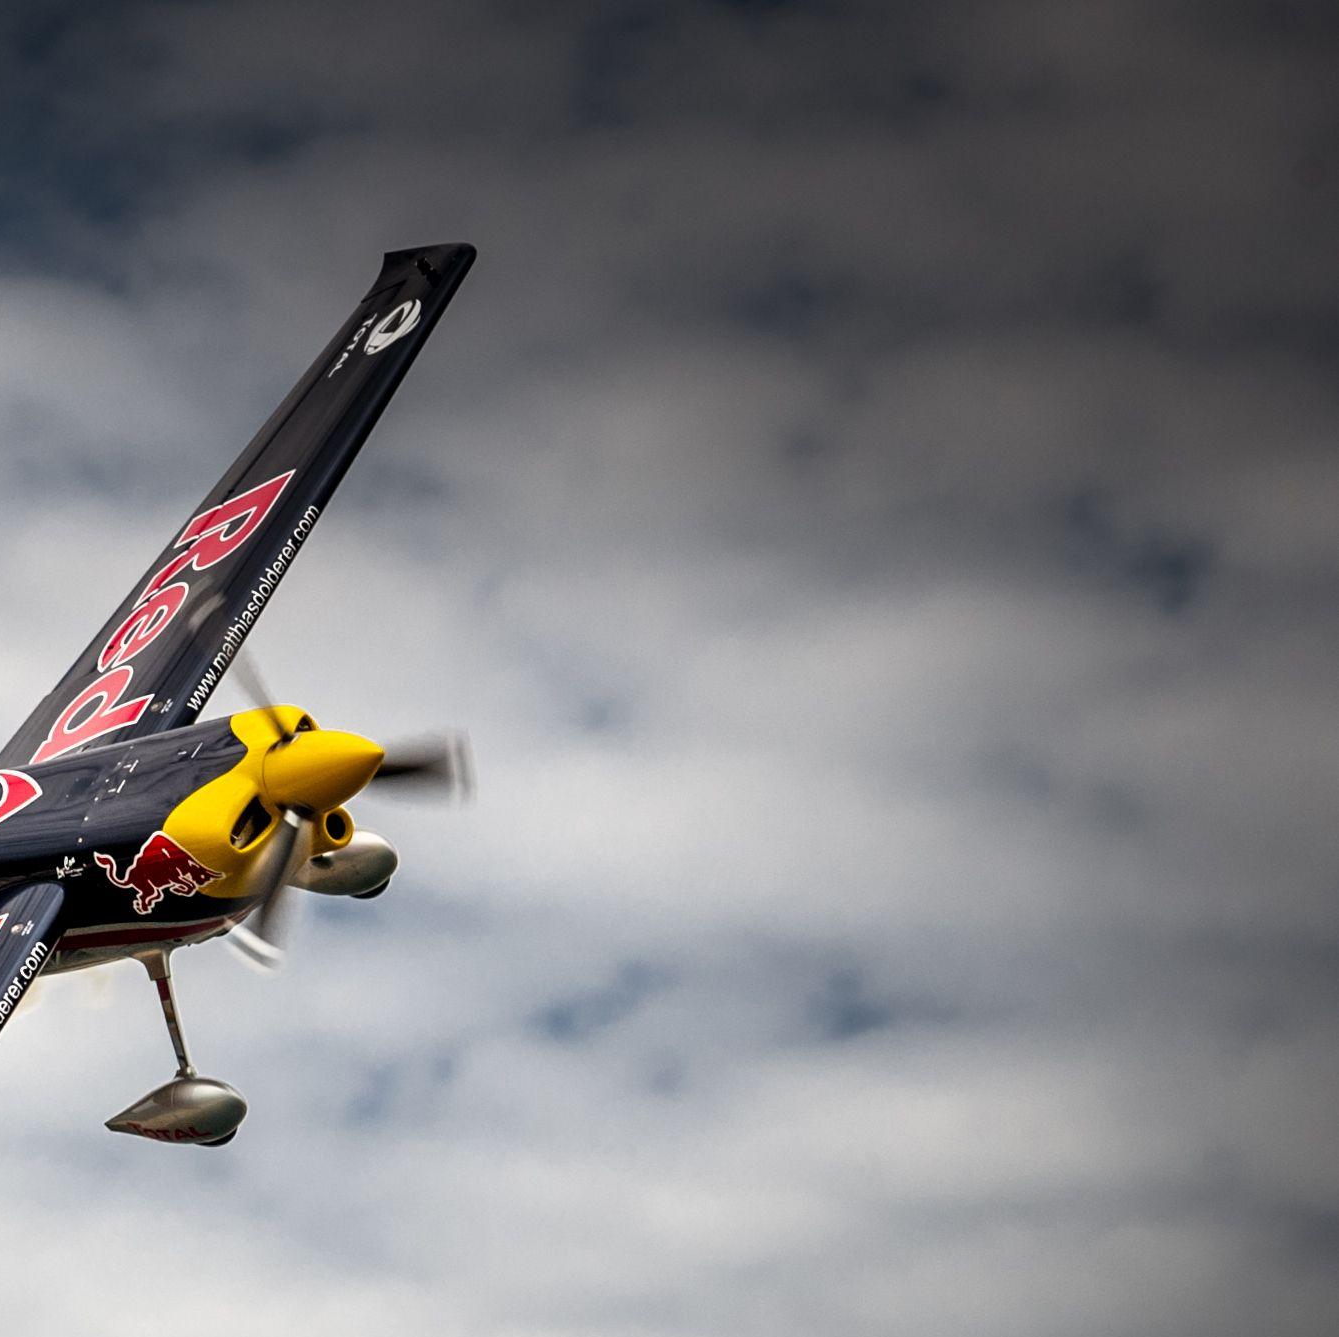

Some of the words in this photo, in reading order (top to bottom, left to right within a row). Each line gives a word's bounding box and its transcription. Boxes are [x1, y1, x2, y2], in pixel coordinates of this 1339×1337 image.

[328, 313, 377, 378] TOTAL
[30, 469, 296, 765] Red
[186, 504, 320, 711] www.matthiasdolderer.com
